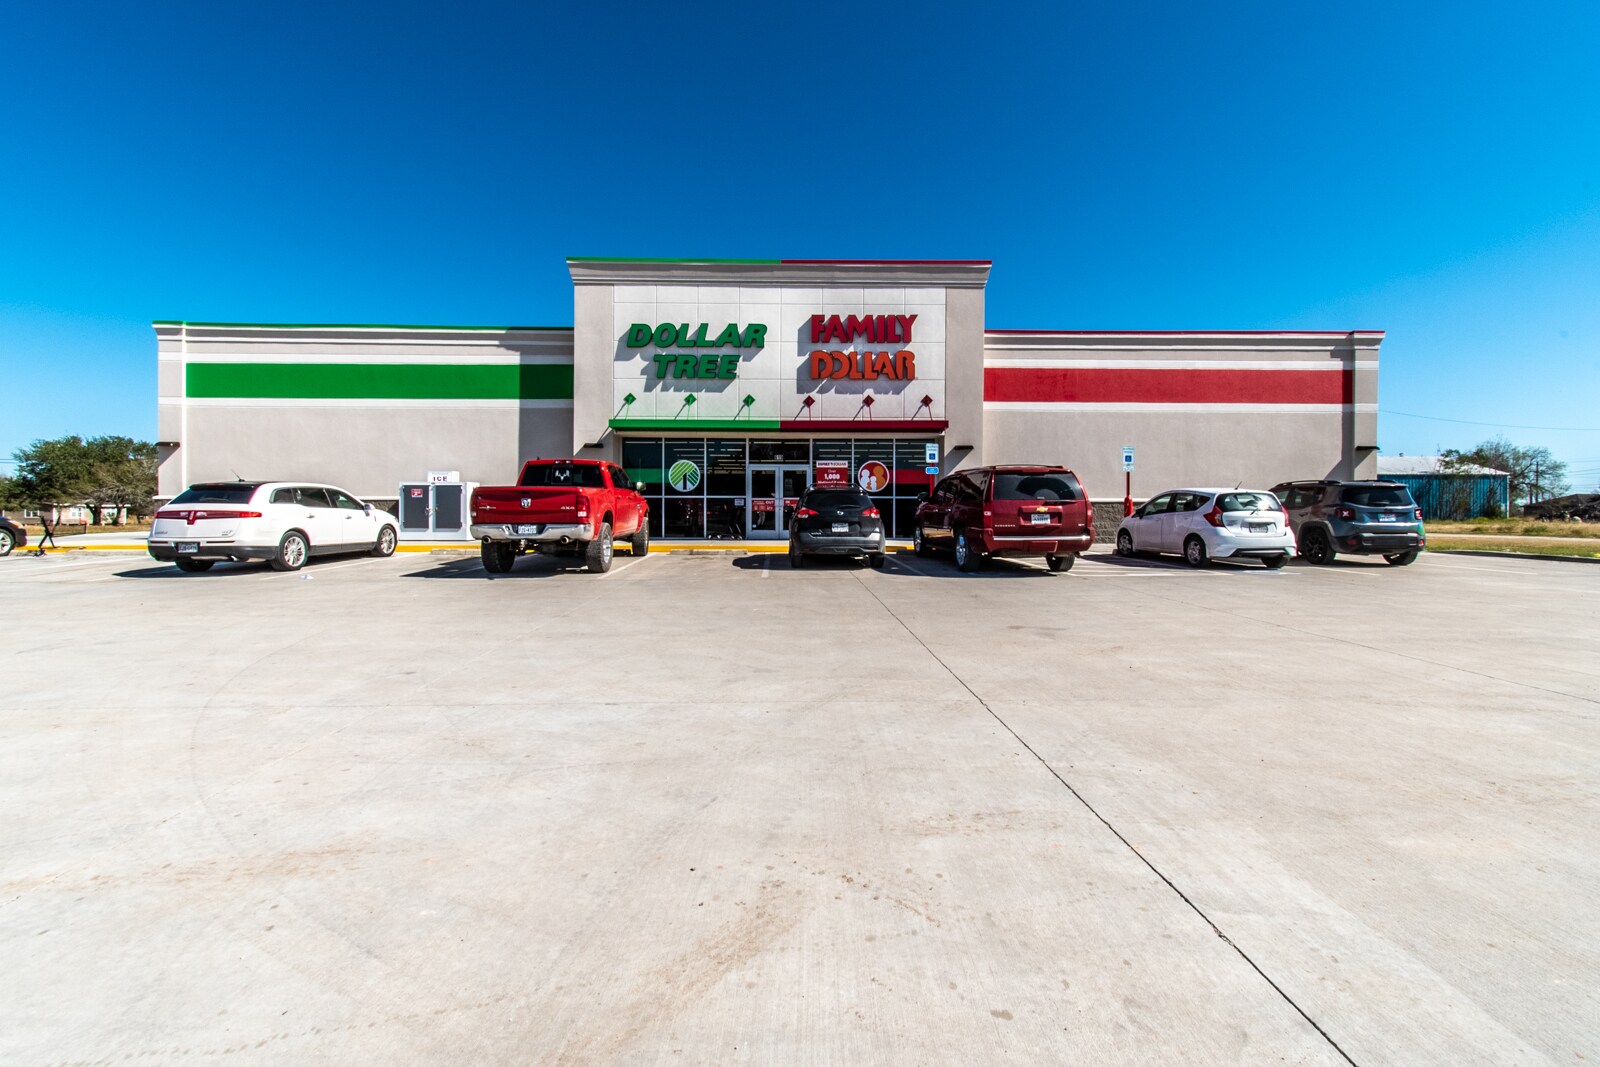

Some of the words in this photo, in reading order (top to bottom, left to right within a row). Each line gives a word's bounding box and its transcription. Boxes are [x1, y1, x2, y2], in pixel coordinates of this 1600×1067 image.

[626, 323, 768, 348] DOLLAR
[810, 314, 918, 343] FAMILY
[652, 354, 740, 380] TREE
[810, 350, 916, 381] DOLLAR
